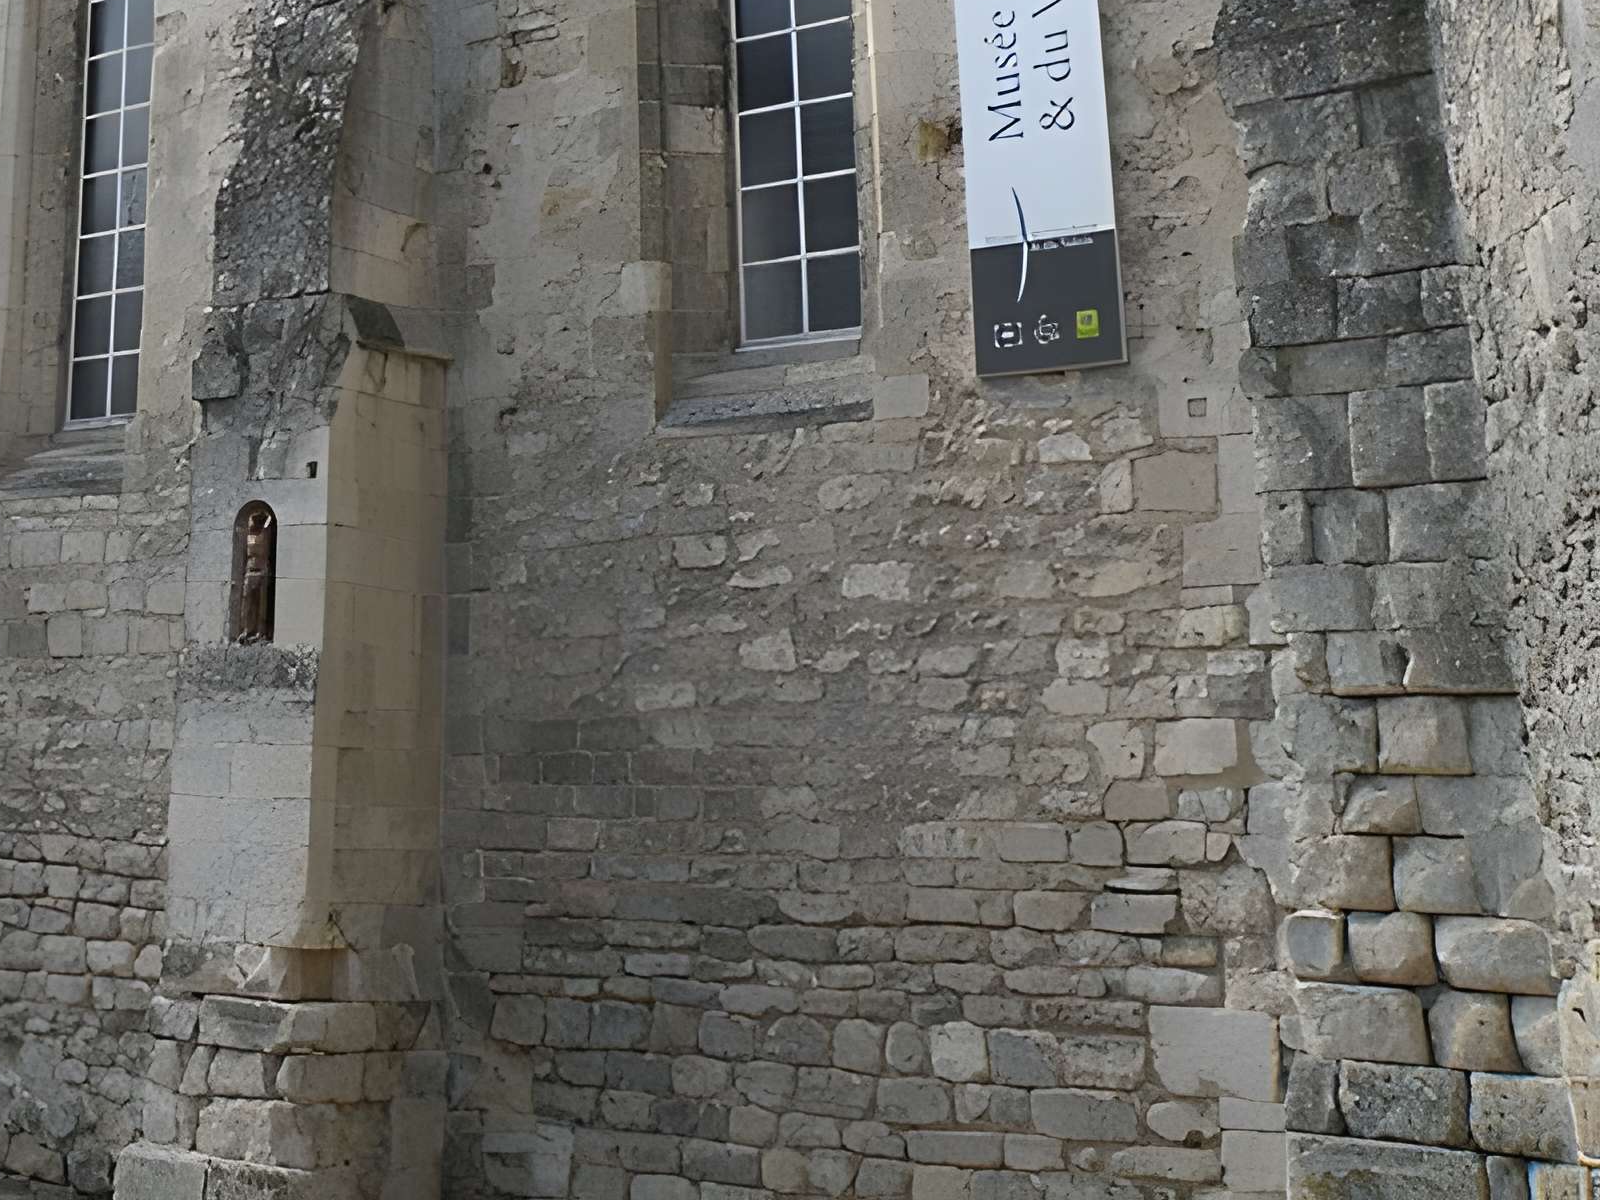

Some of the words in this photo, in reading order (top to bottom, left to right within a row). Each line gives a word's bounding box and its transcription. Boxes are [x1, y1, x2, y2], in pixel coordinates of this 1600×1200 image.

[983, 10, 1024, 141] Musée
[1032, 29, 1072, 82] du
[1038, 96, 1075, 130] &
